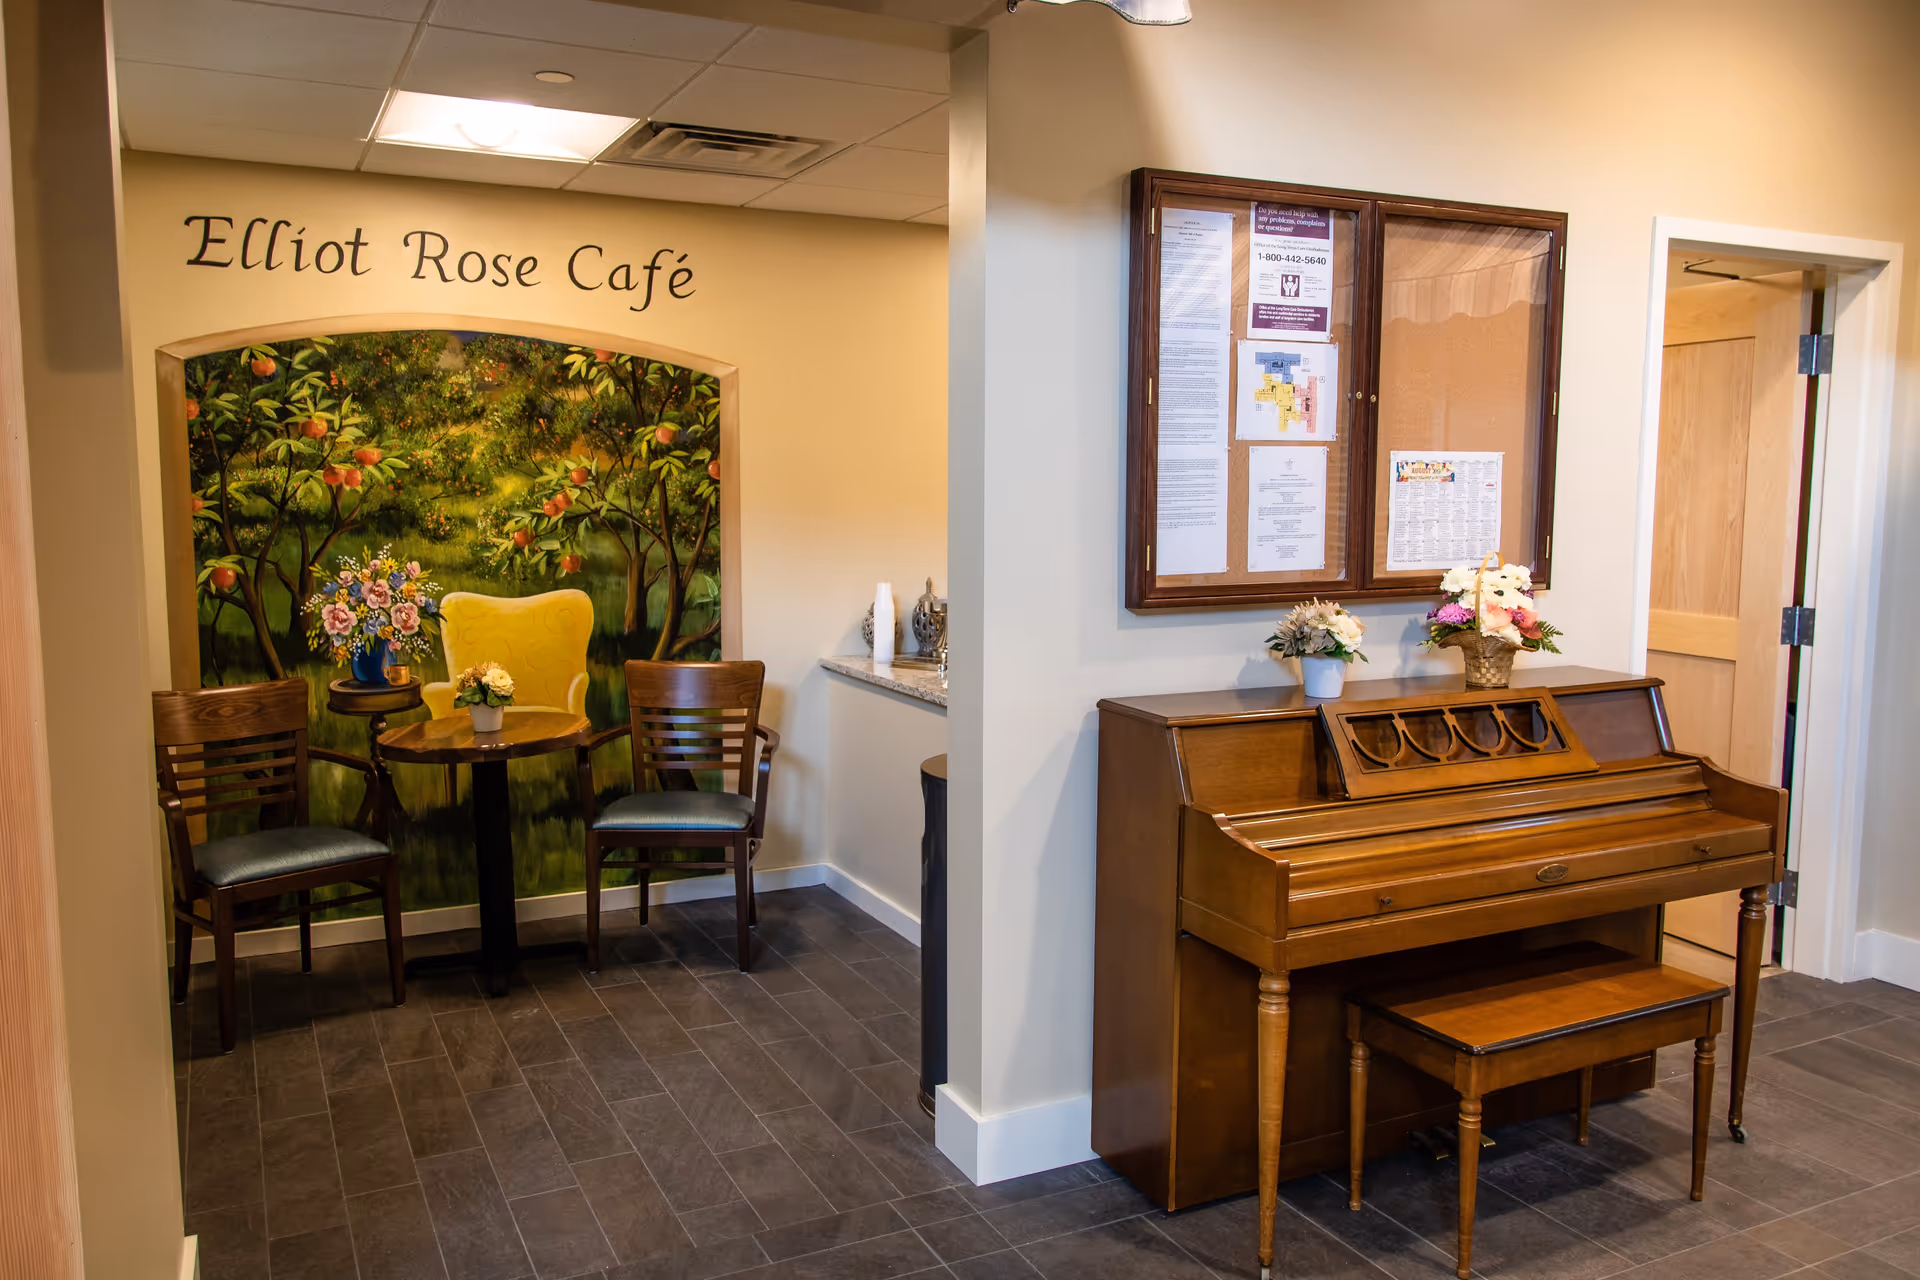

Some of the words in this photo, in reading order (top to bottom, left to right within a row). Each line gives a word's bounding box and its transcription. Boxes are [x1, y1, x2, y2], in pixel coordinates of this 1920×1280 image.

[1293, 210, 1305, 218] help
[1296, 219, 1326, 227] complaints
[1265, 225, 1294, 233] questions?
[1257, 252, 1327, 266] 1-800-442-5640
[184, 215, 371, 276] Elliot
[403, 230, 541, 287] Rose
[567, 244, 696, 312] Café
